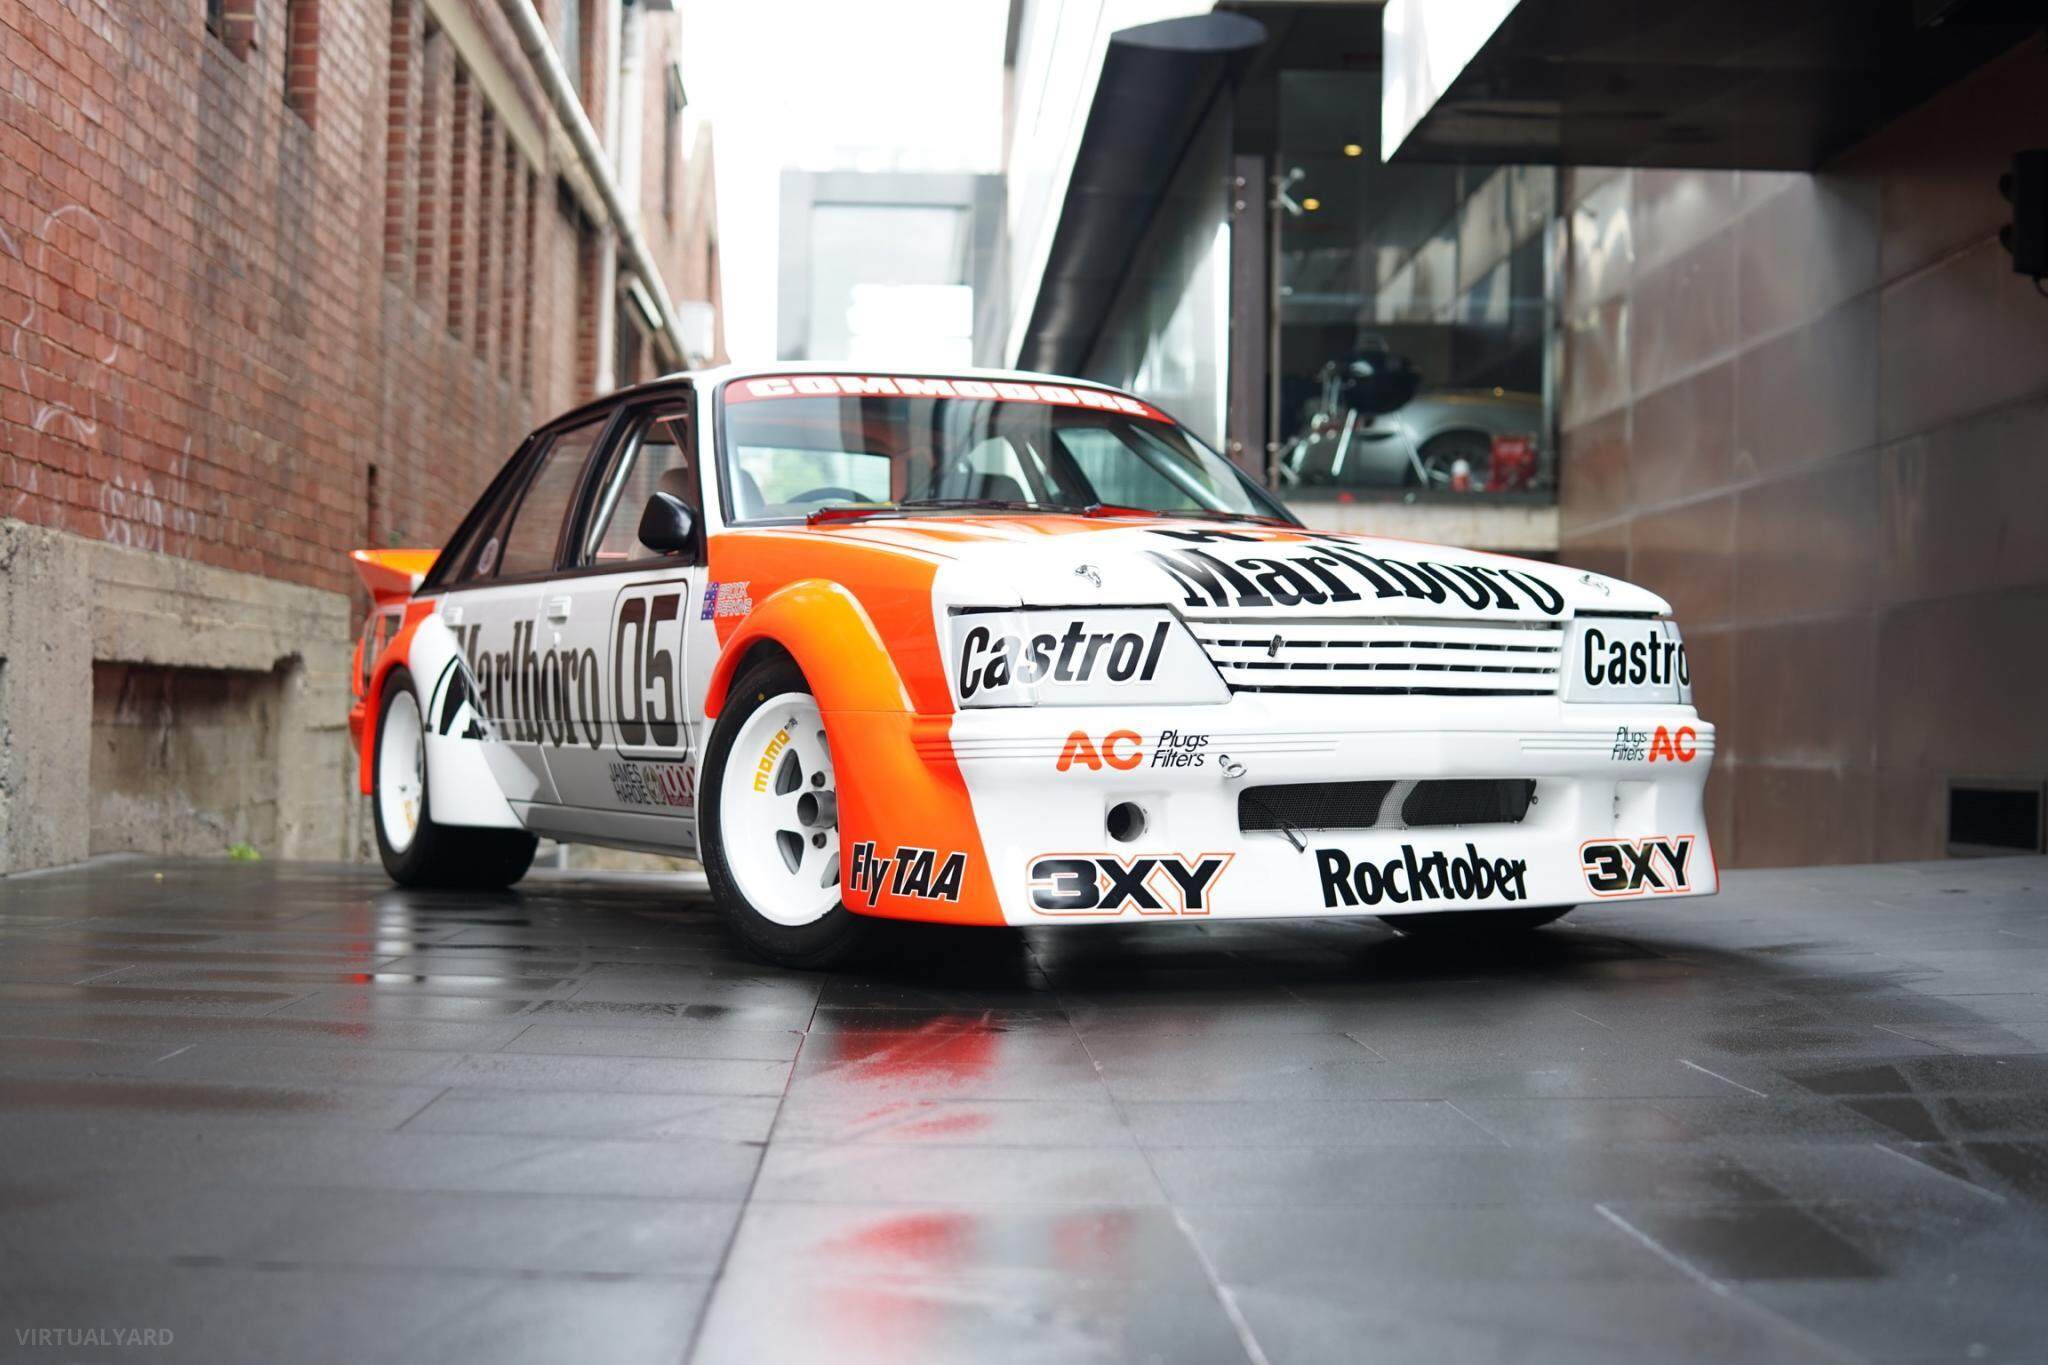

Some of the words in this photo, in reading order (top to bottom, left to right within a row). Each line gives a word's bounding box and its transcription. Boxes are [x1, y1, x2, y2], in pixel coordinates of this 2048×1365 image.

[747, 376, 1150, 417] COMMODORE
[1146, 530, 1566, 616] Marlboro
[615, 593, 681, 747] 05
[960, 621, 1171, 700] Castrol
[426, 619, 603, 751] Marlboro
[1056, 729, 1143, 772] AC
[1157, 730, 1209, 753] Plugs
[1611, 744, 1645, 761] Filters
[1616, 726, 1648, 748] Plugs
[1648, 725, 1696, 763] AC
[609, 762, 642, 783] JAMES
[1151, 749, 1205, 769] Filters
[1030, 856, 1228, 912] 3XY
[1315, 842, 1528, 908] Rocktober
[1582, 837, 1695, 895] 3XY
